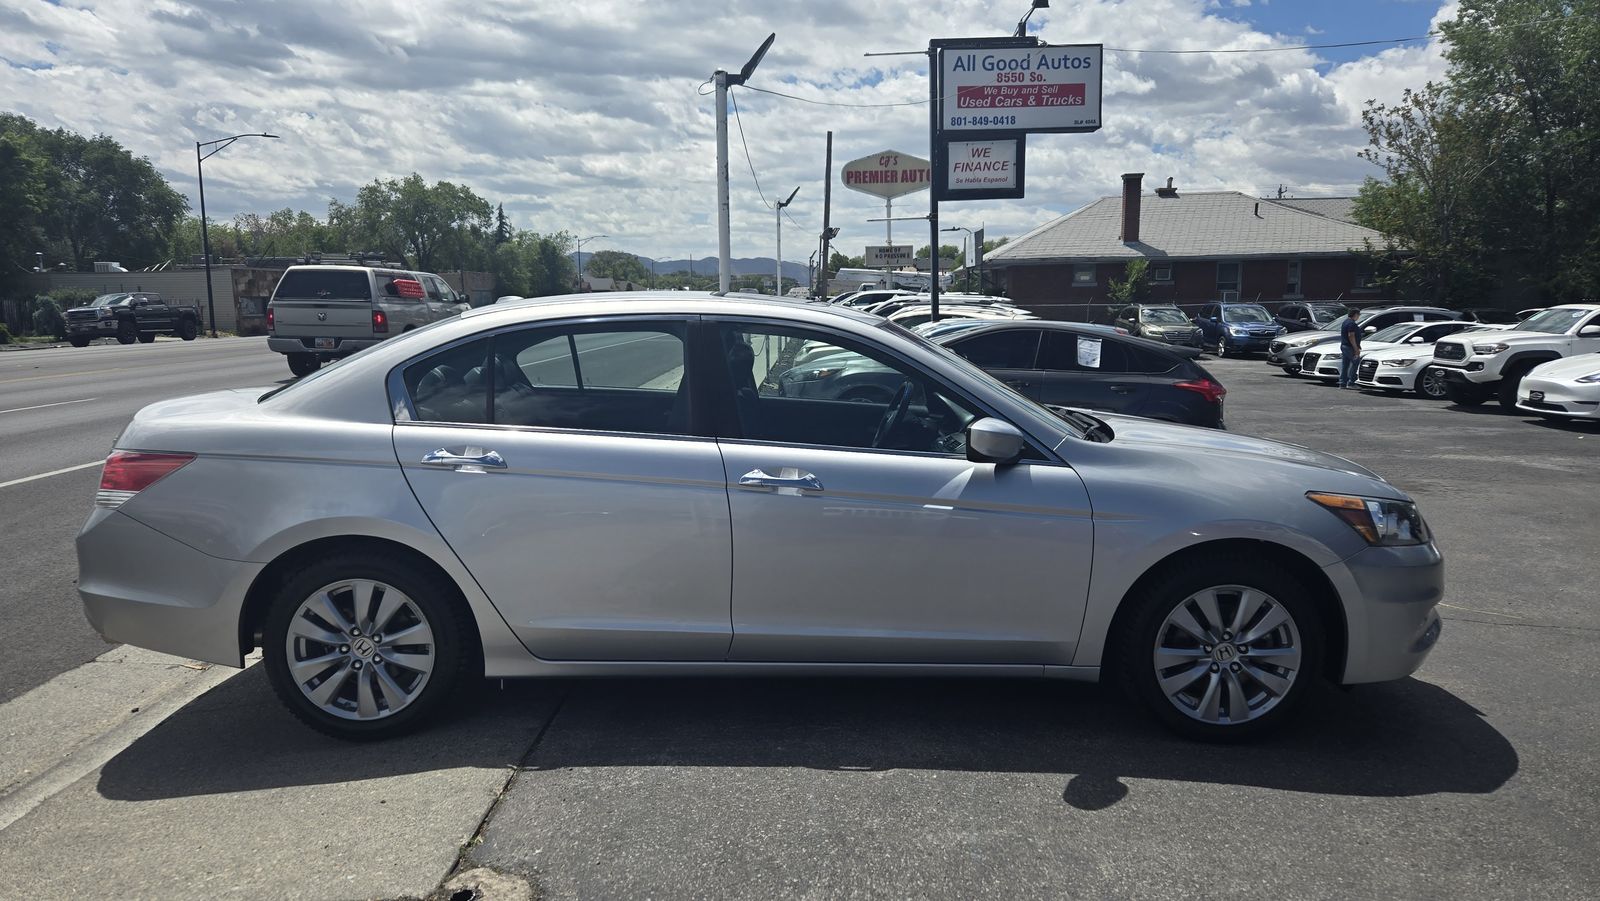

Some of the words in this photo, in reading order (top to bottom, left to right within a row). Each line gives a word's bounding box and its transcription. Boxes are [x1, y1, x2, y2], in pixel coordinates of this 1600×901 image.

[952, 54, 976, 72] All
[982, 53, 1031, 71] Good
[1036, 54, 1091, 70] Autos
[996, 72, 1025, 83] 8550
[1029, 71, 1046, 82] So.
[984, 86, 998, 95] We
[1000, 86, 1019, 96] Buy
[1021, 86, 1039, 94] and
[1041, 85, 1059, 94] Sell
[960, 96, 991, 108] Used
[995, 96, 1023, 107] Cars
[1027, 95, 1036, 106] &
[1041, 94, 1083, 106] Trucks
[950, 115, 1016, 126] 801-849-0418
[971, 147, 992, 158] WE
[953, 160, 1010, 173] FINANCE
[846, 169, 898, 185] PREMIER
